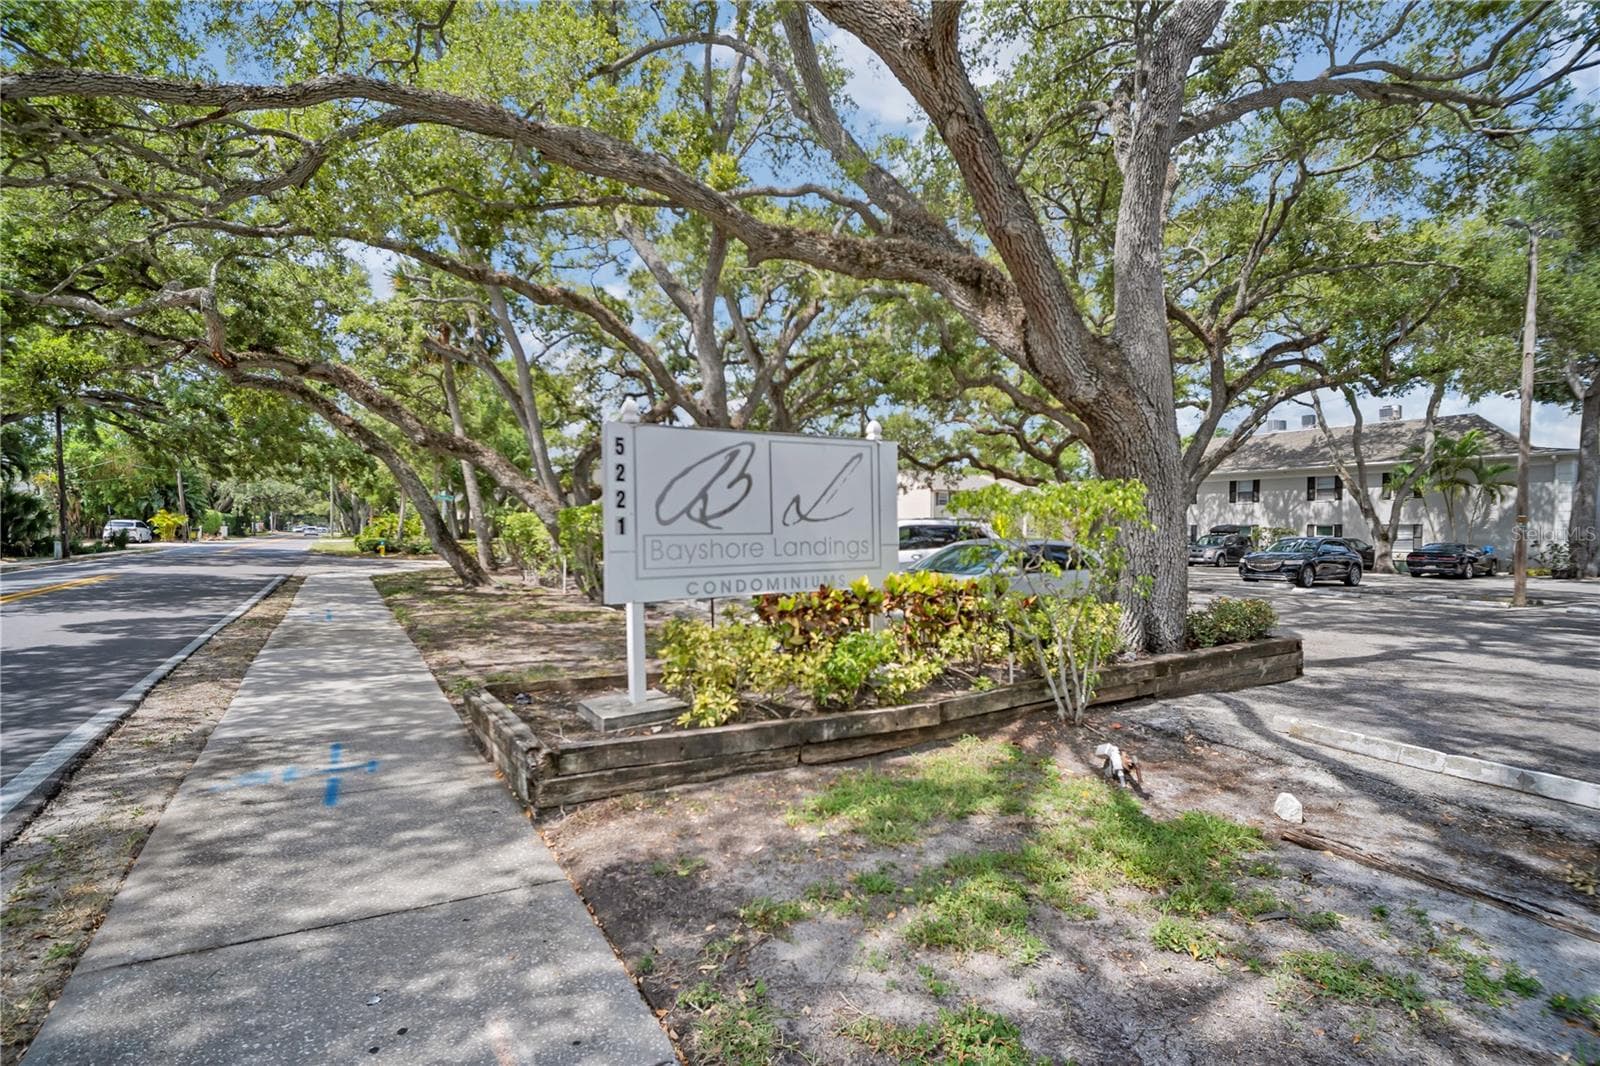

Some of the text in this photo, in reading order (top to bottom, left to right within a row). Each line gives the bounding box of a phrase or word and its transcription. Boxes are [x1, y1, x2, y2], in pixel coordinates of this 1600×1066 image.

[615, 437, 626, 536] 5221
[650, 536, 870, 565] Bayshore Landings
[686, 574, 847, 596] CONDOMINIUMS
